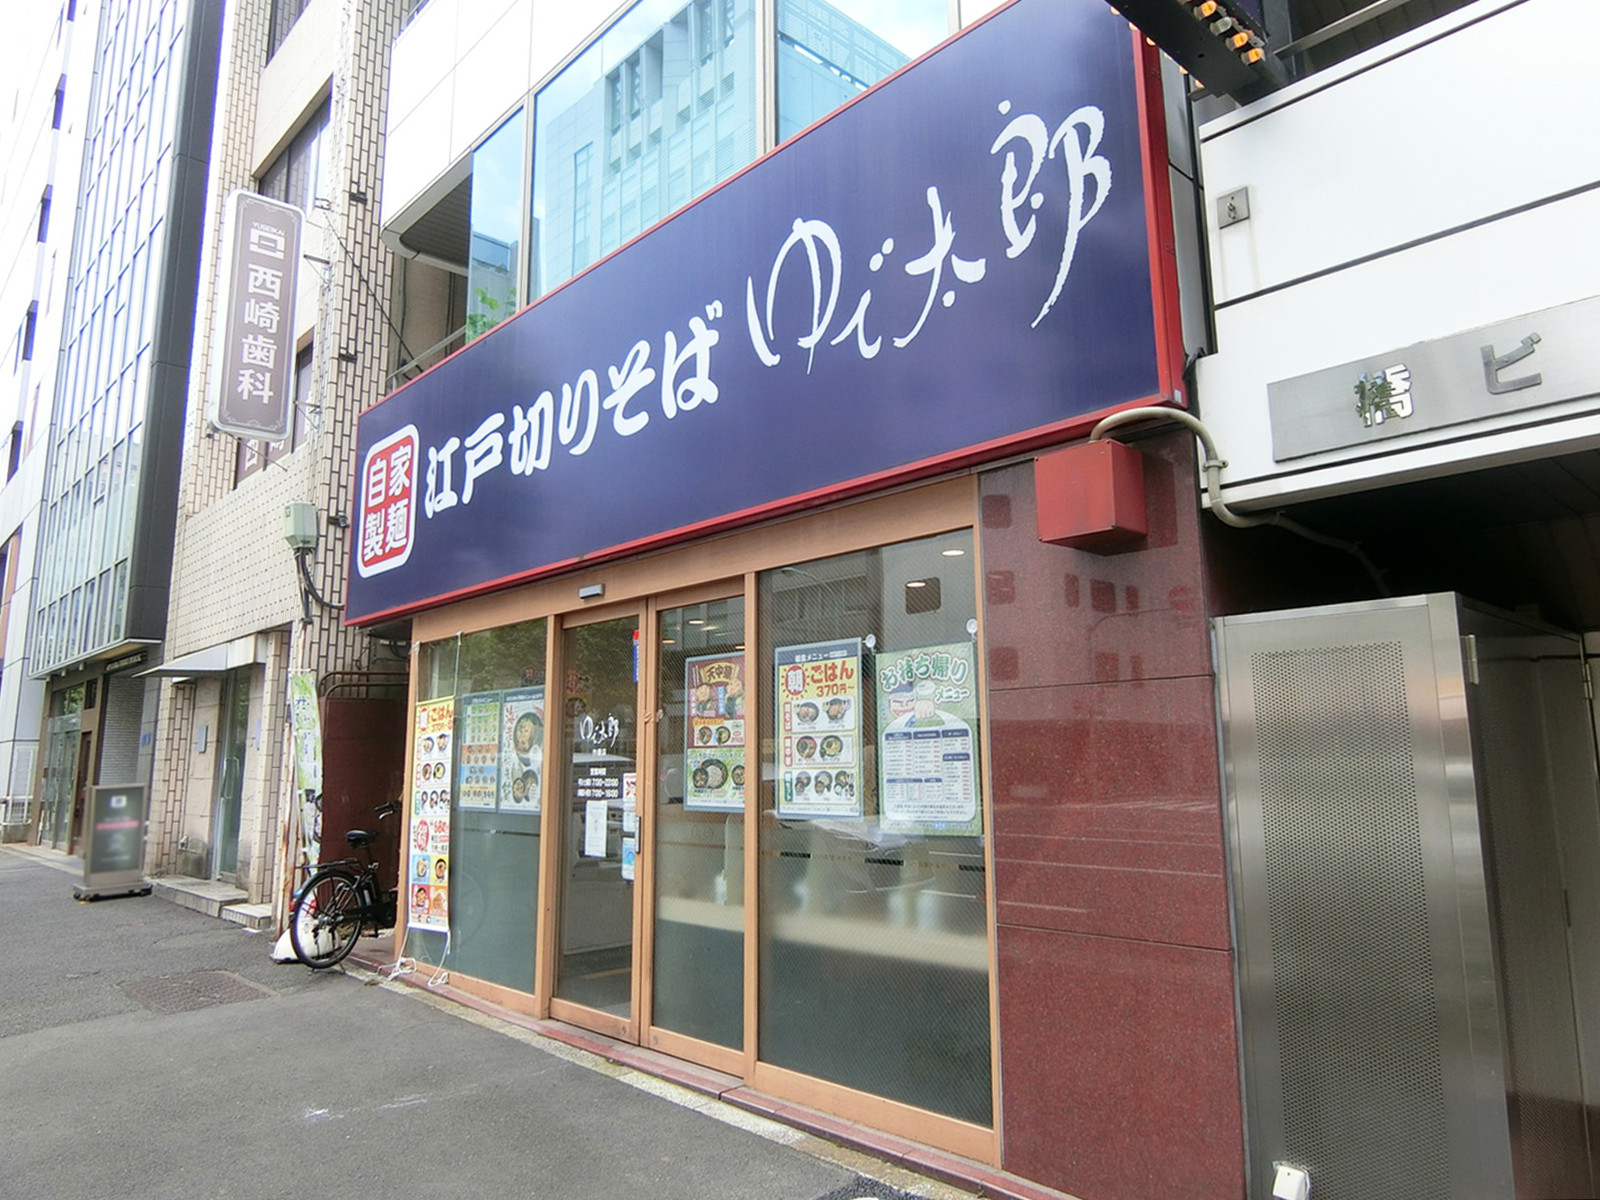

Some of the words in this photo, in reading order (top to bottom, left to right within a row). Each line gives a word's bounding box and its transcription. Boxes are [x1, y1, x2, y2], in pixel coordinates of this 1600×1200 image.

[237, 264, 283, 404] 西崎歯科
[425, 300, 722, 519] 江戸切りそば
[368, 445, 411, 508] 自家
[364, 498, 408, 562] 製麺
[811, 660, 854, 683] ごはん
[881, 653, 968, 690] お持ち帰り
[935, 687, 970, 703] メニュー
